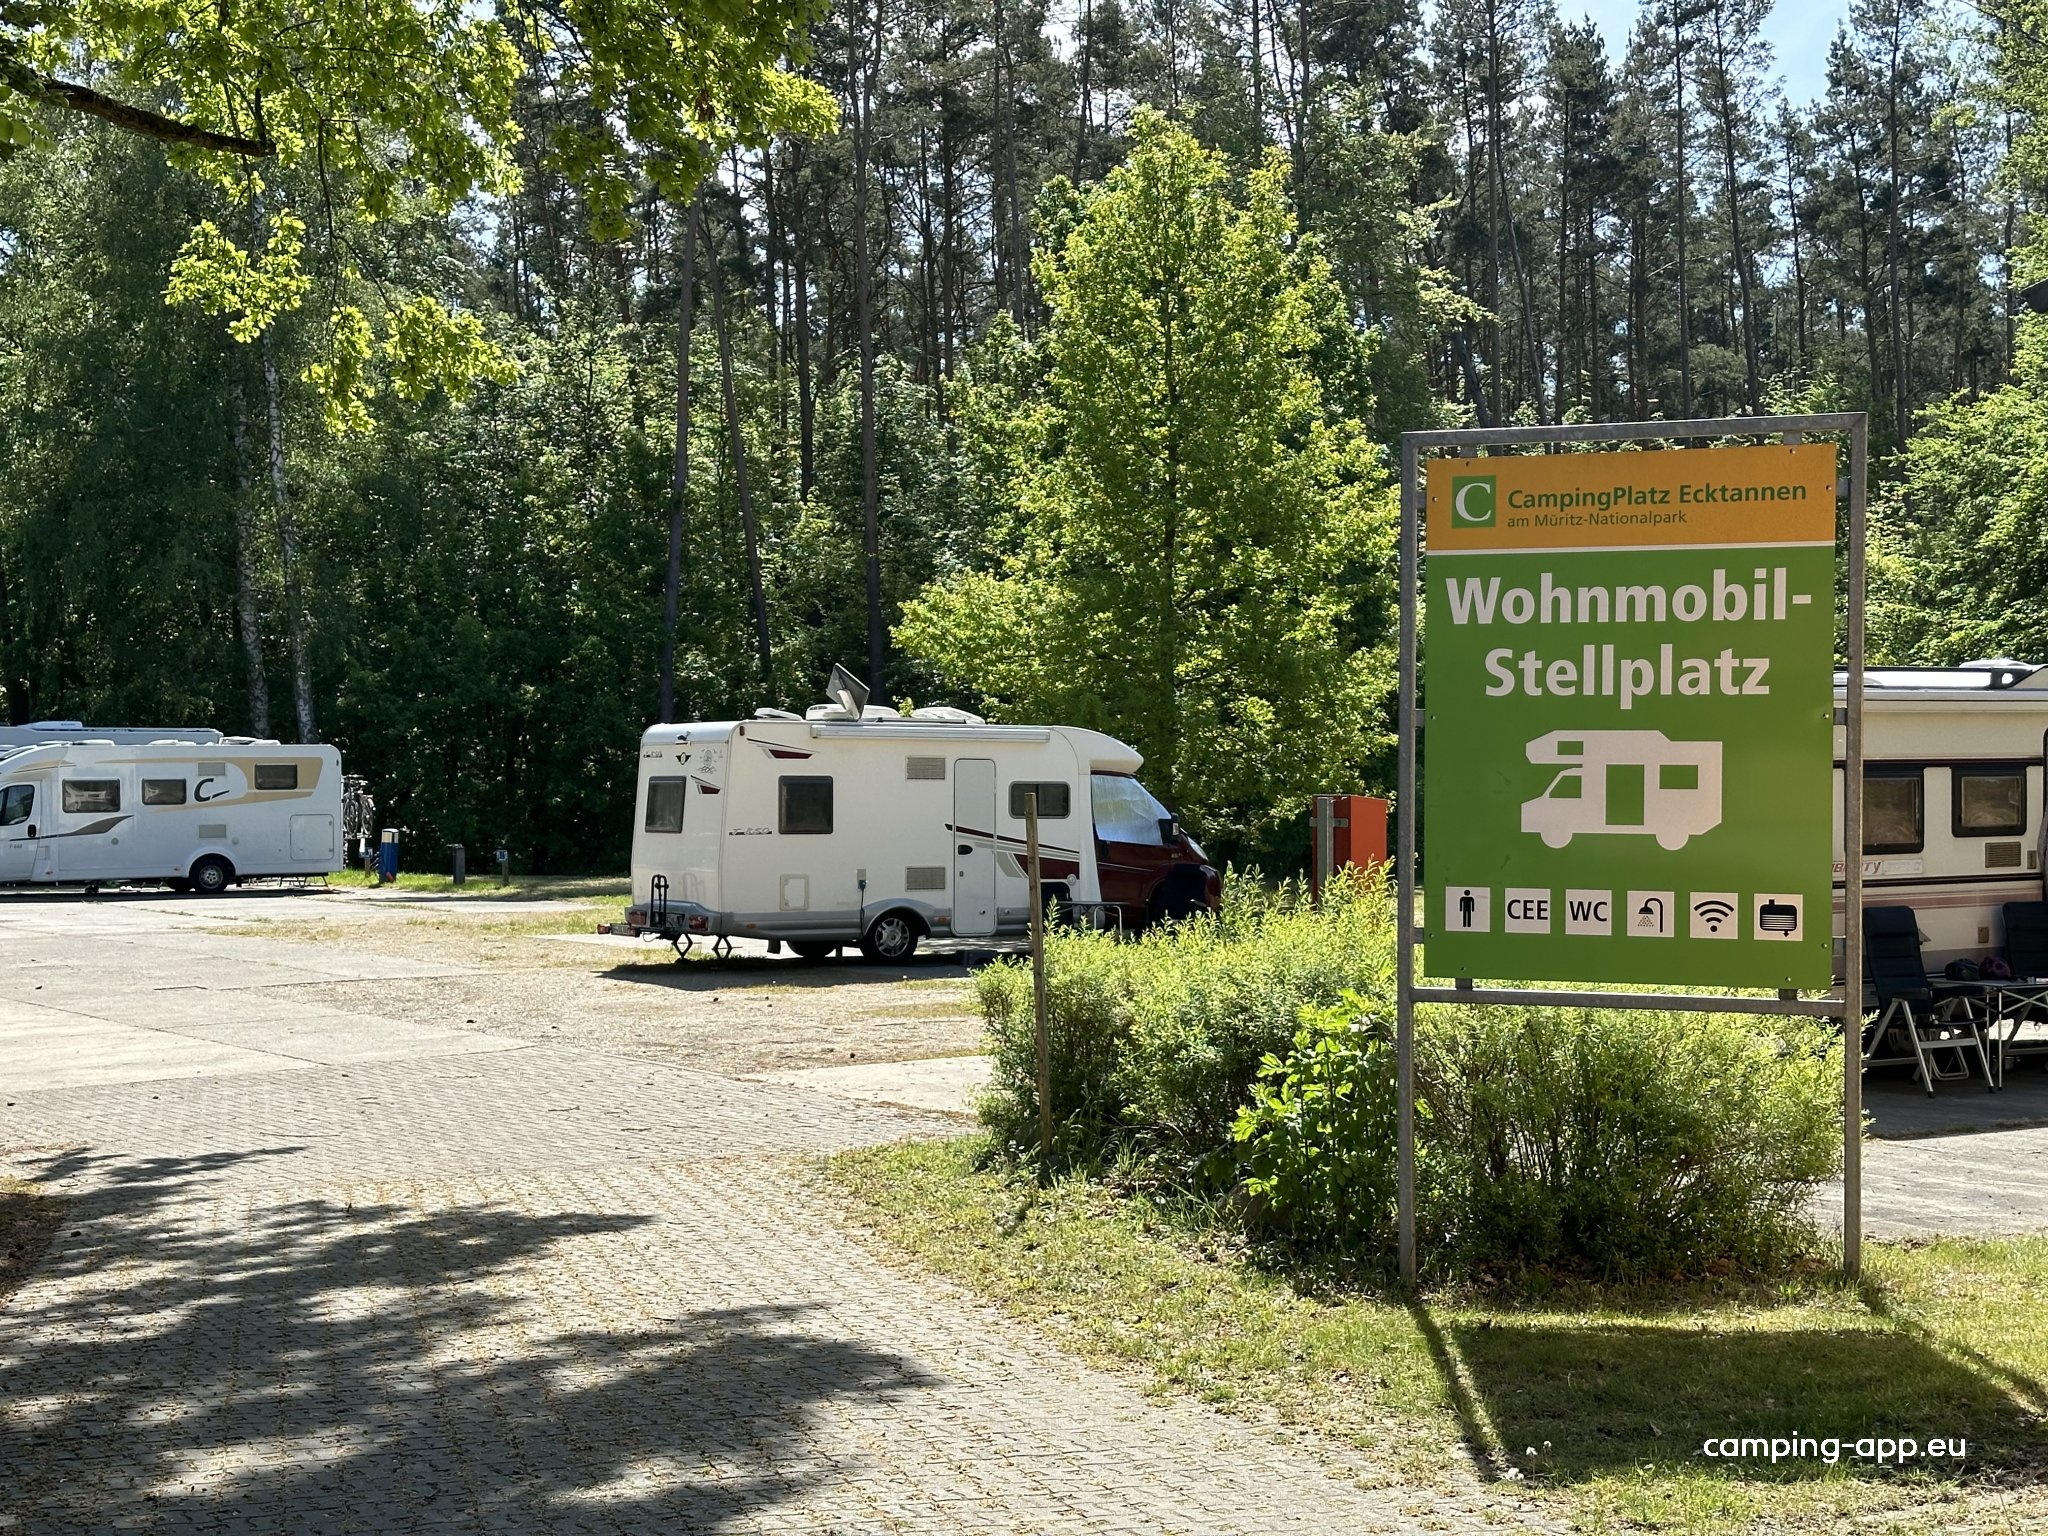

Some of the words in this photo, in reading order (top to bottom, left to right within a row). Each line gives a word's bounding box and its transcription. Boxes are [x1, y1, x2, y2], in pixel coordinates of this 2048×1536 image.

[1455, 482, 1491, 521] C
[1507, 485, 1671, 512] CampingPlatz
[1679, 482, 1807, 504] Ecktannen
[1507, 516, 1530, 528] am
[1534, 510, 1687, 528] Müritz-Nationalpark
[1445, 567, 1812, 626] Wohnmobil-
[1485, 643, 1770, 710] Stellplatz
[1507, 899, 1549, 921] CEE
[1569, 900, 1608, 922] WC
